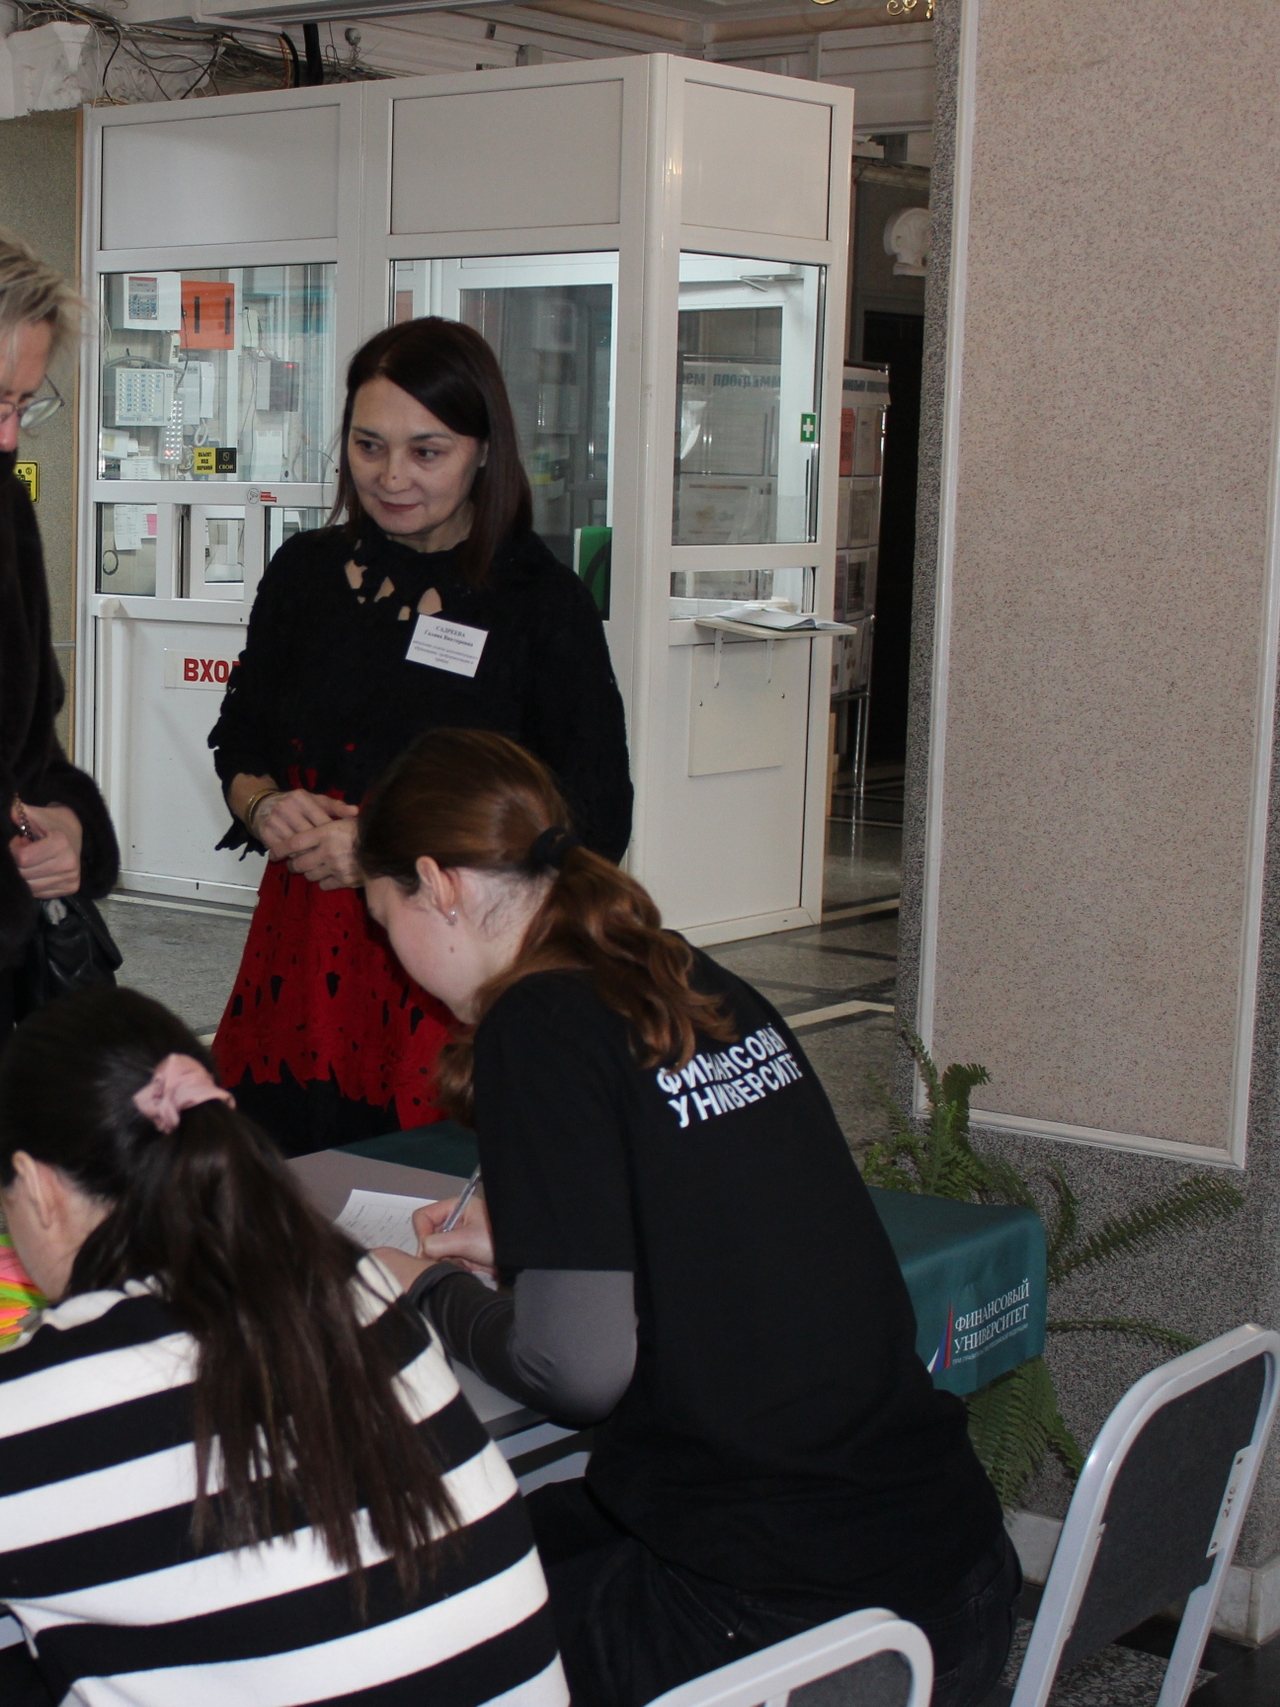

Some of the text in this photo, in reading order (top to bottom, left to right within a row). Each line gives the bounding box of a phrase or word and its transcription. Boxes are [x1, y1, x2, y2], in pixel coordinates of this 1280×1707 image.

[183, 657, 241, 683] ВХО
[656, 1024, 788, 1095] ФИНАНСОВЫ
[667, 1053, 803, 1129] УНИВЕРСИТЕ
[954, 1303, 1030, 1354] УНИВЕРСИТЕТ
[955, 1278, 1030, 1332] ФИНАНСОВЫЙ
